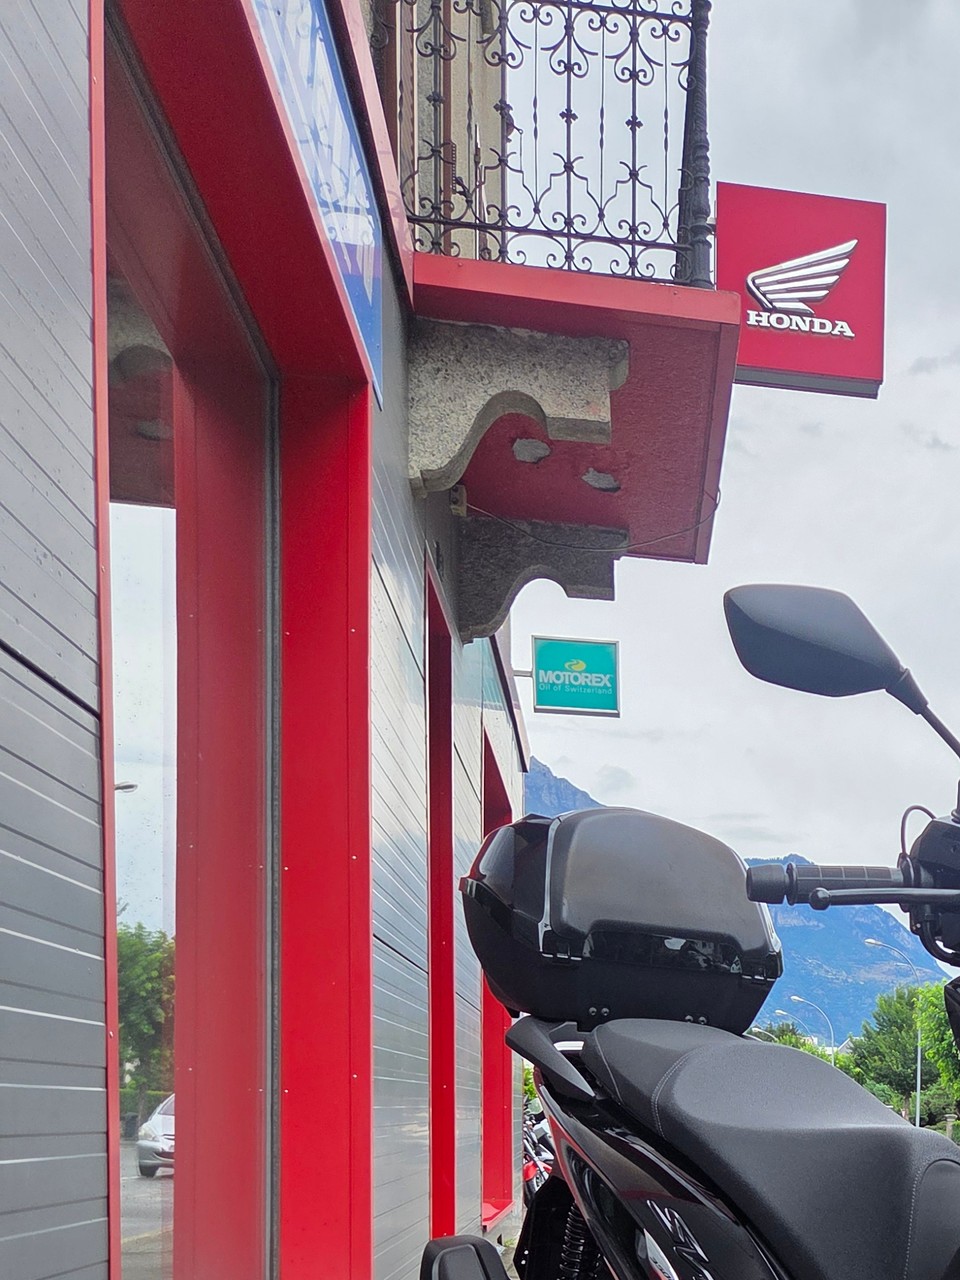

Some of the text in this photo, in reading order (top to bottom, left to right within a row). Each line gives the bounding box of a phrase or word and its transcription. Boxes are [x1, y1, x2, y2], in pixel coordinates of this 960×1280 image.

[746, 311, 855, 337] HONDA
[539, 670, 612, 687] MOTOREX
[539, 683, 550, 691] Oil
[565, 685, 612, 694] Switzerland
